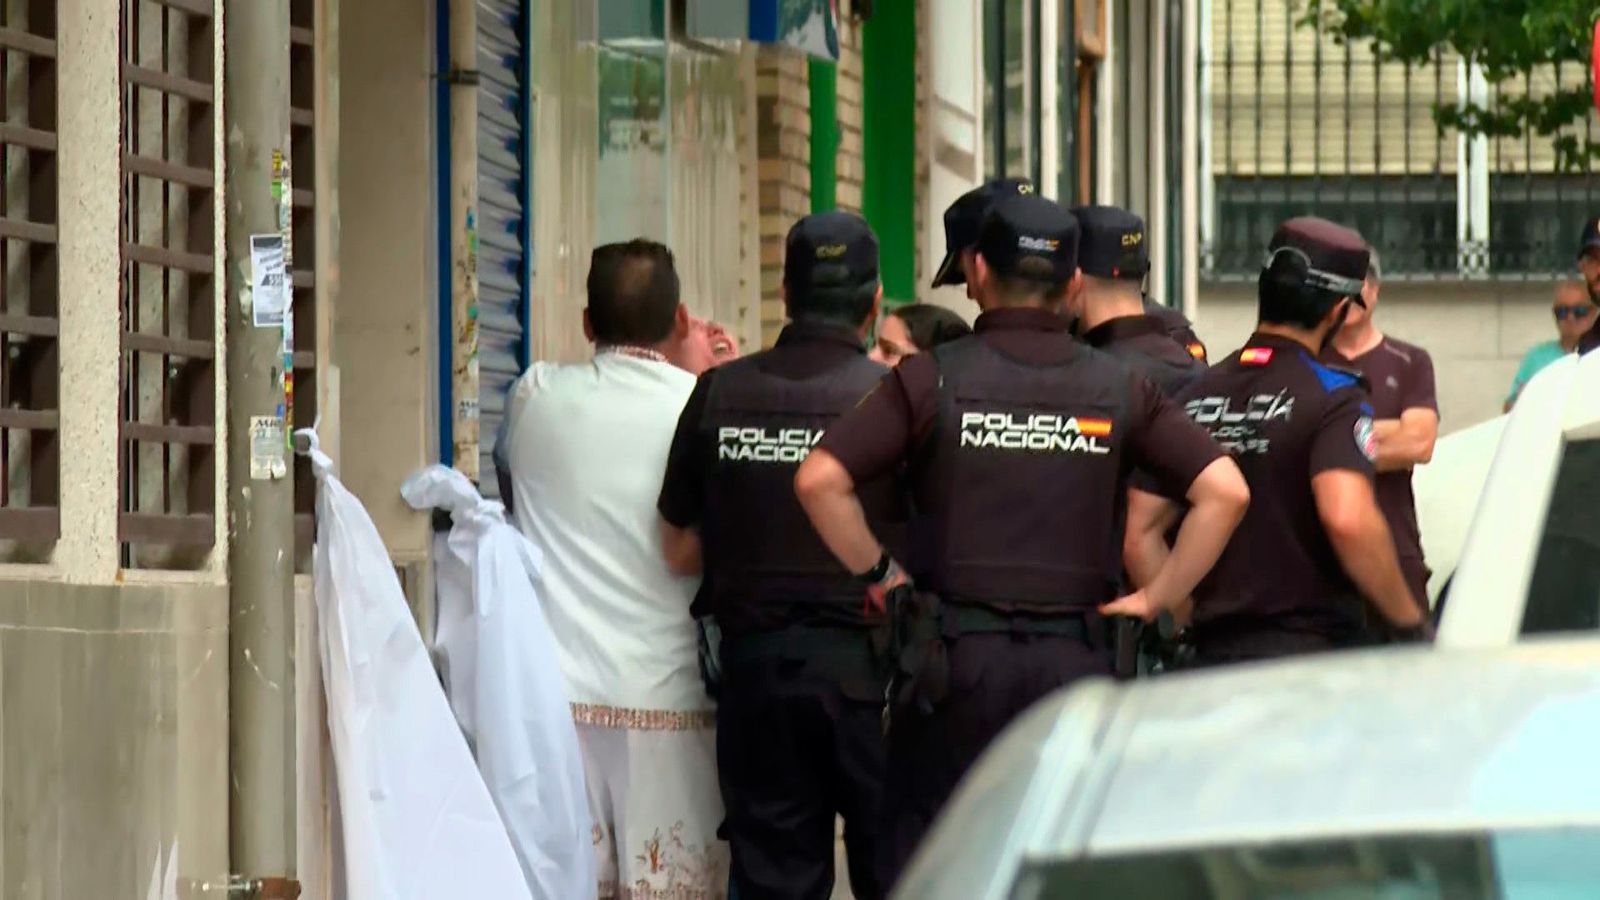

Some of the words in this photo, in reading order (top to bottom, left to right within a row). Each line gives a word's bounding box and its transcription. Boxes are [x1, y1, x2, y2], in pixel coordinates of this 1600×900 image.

[961, 411, 1081, 435] POLICIA
[718, 443, 810, 462] NACIO
[960, 429, 1111, 454] NACIONAL
